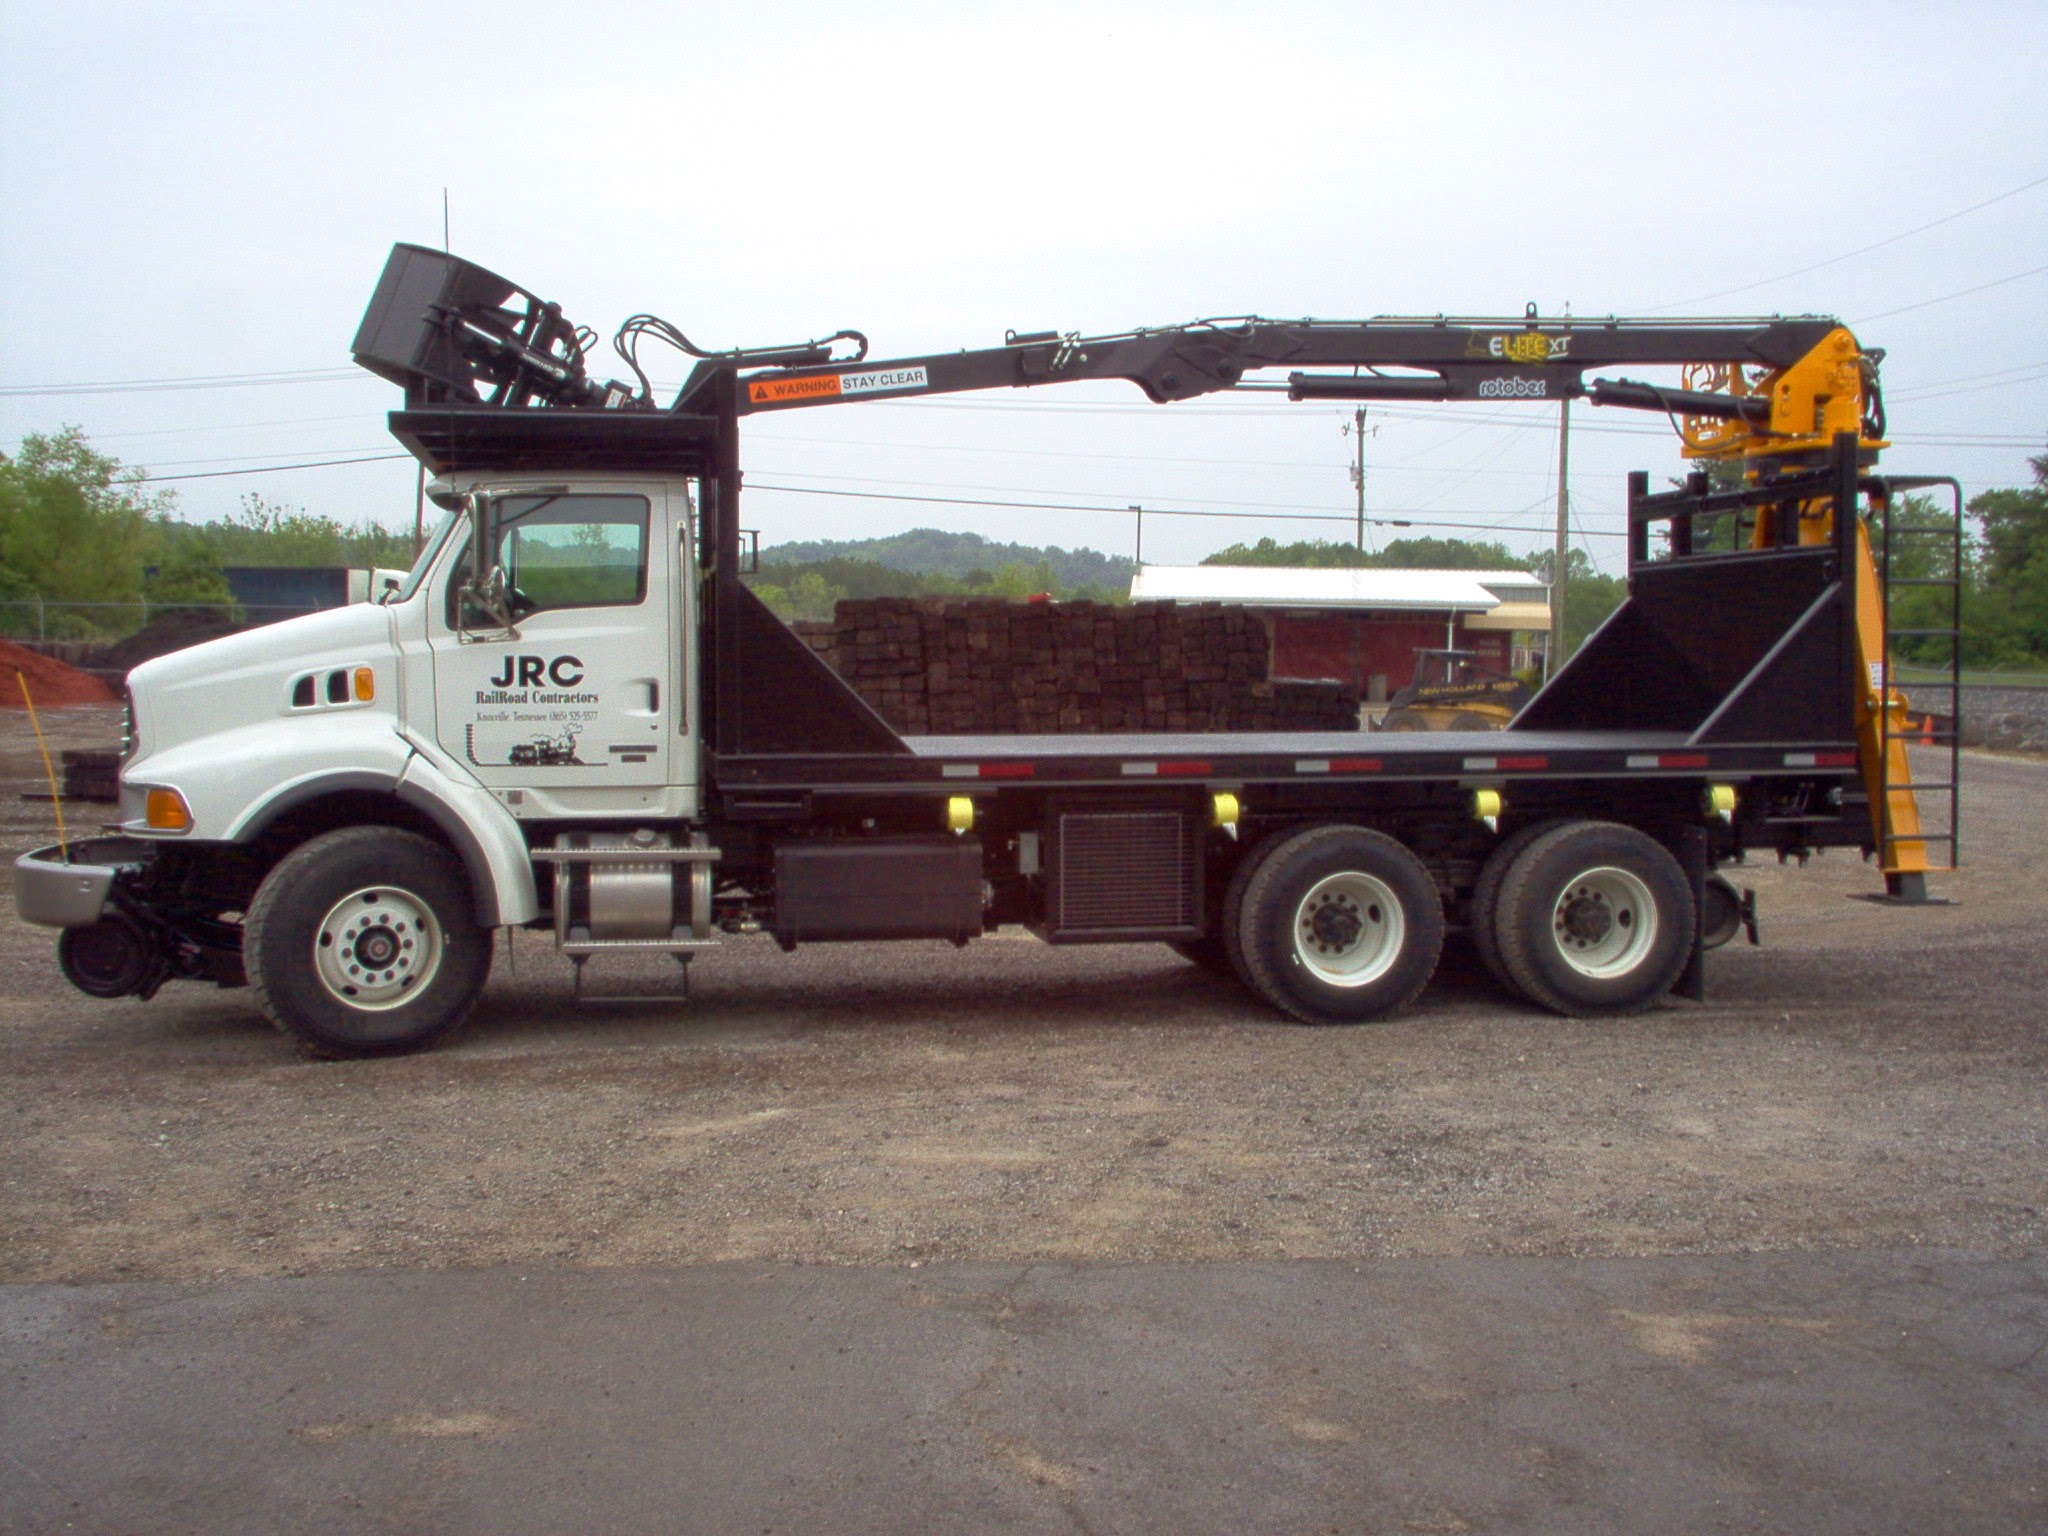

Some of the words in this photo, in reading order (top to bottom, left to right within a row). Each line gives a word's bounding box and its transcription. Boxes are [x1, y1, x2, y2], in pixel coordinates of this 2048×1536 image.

[1489, 334, 1547, 357] ELITE
[1549, 335, 1572, 352] XT
[774, 379, 837, 395] WARNING
[842, 374, 878, 389] STAY
[880, 371, 924, 386] CLEAR
[490, 655, 584, 688] JRC
[476, 690, 528, 704] RailRoad
[532, 690, 599, 704] Contractors
[1419, 688, 1440, 696] NEW
[1442, 682, 1486, 693] HOLLAND
